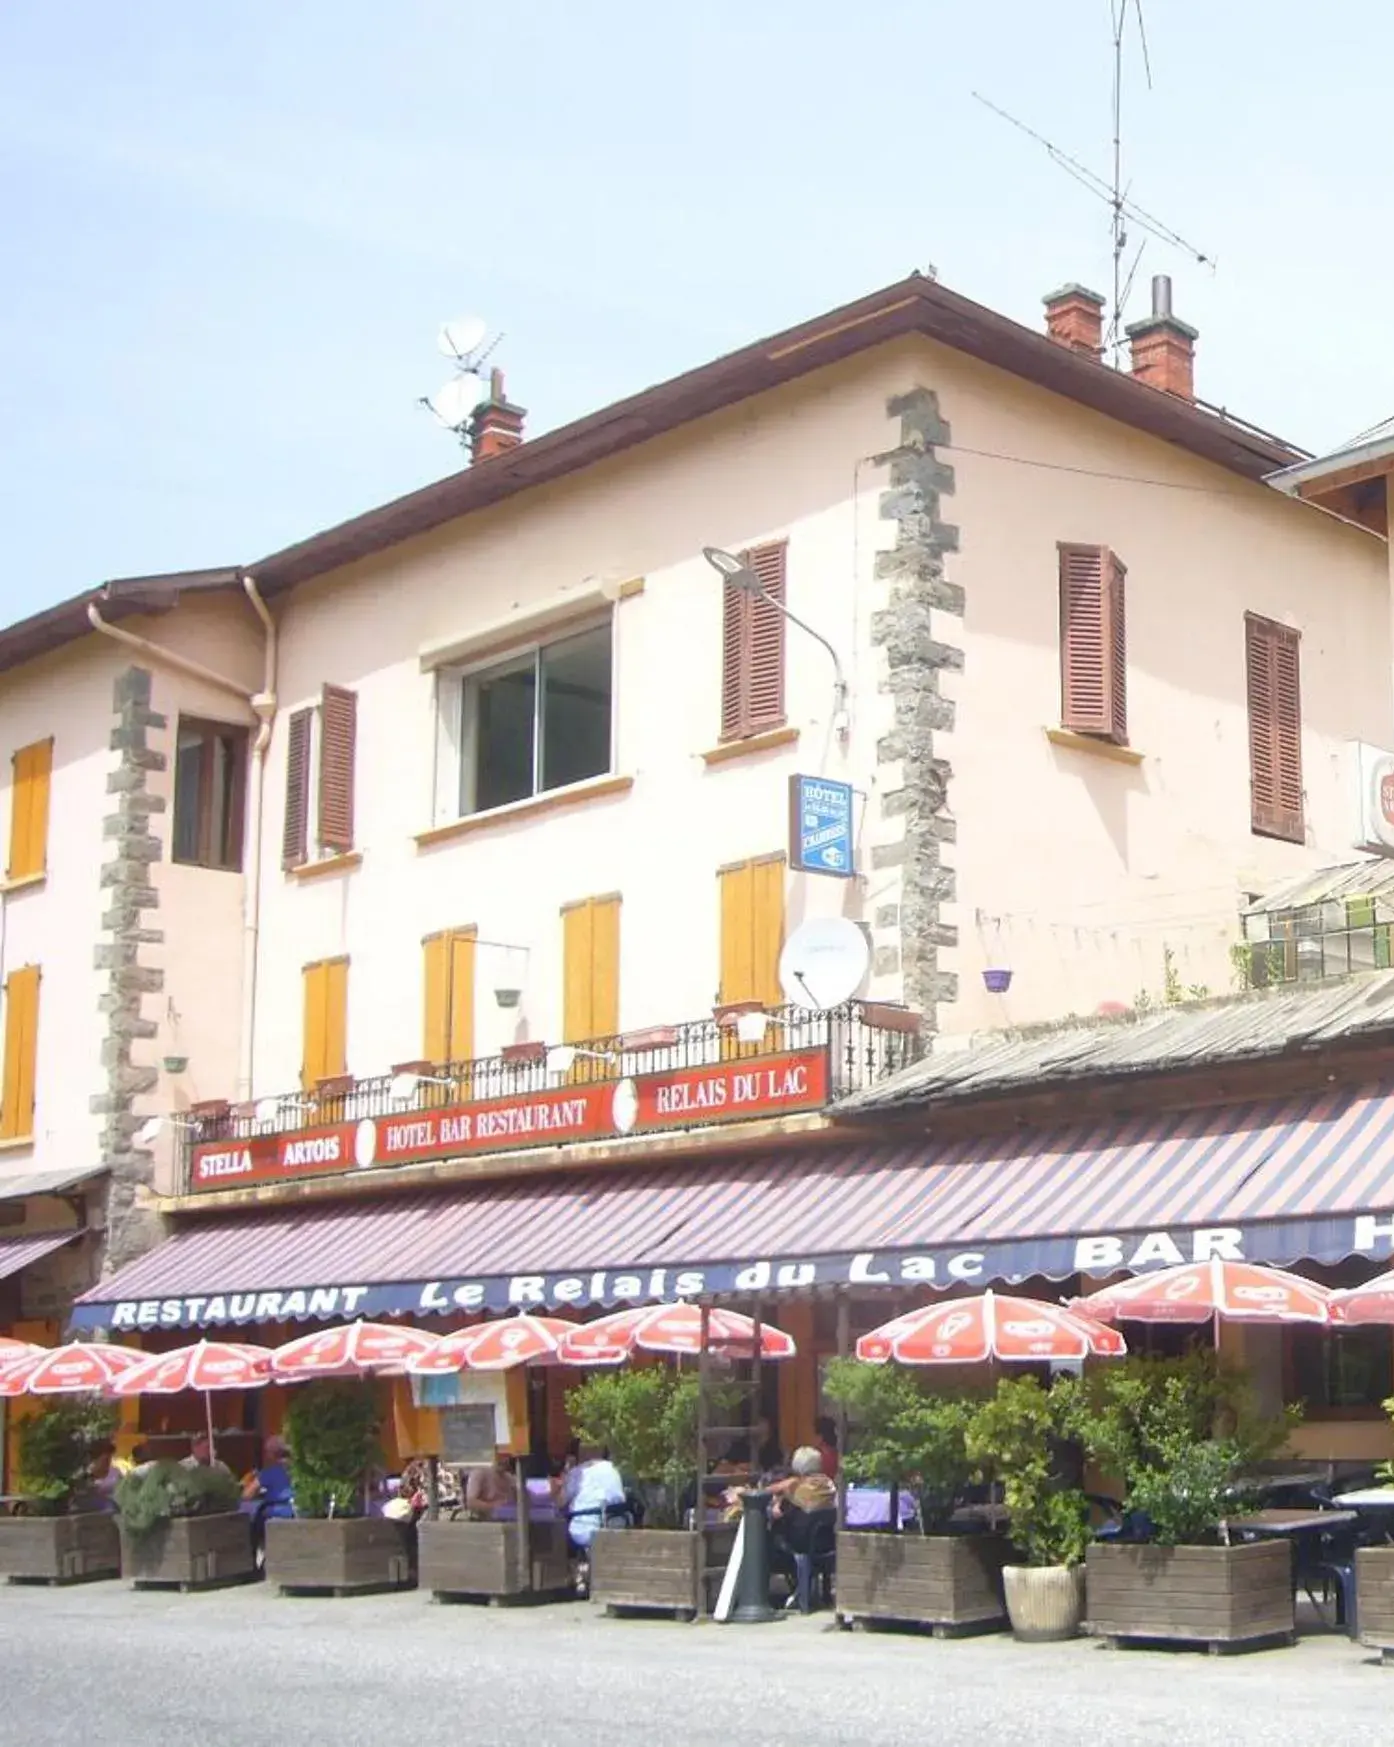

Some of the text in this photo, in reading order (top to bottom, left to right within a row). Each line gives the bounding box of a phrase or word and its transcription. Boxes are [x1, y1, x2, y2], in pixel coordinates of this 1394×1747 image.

[657, 1066, 808, 1113] RELAIS DU LAC
[387, 1098, 587, 1150] HOTEL BAR RESTAURANT
[199, 1137, 340, 1177] STELLA ARTOIS
[111, 1286, 368, 1326] RESTAURANT
[420, 1281, 485, 1310] Le
[508, 1268, 706, 1303] Relais
[734, 1261, 816, 1290] du
[848, 1252, 986, 1283] Lac
[1073, 1227, 1246, 1269] BAR
